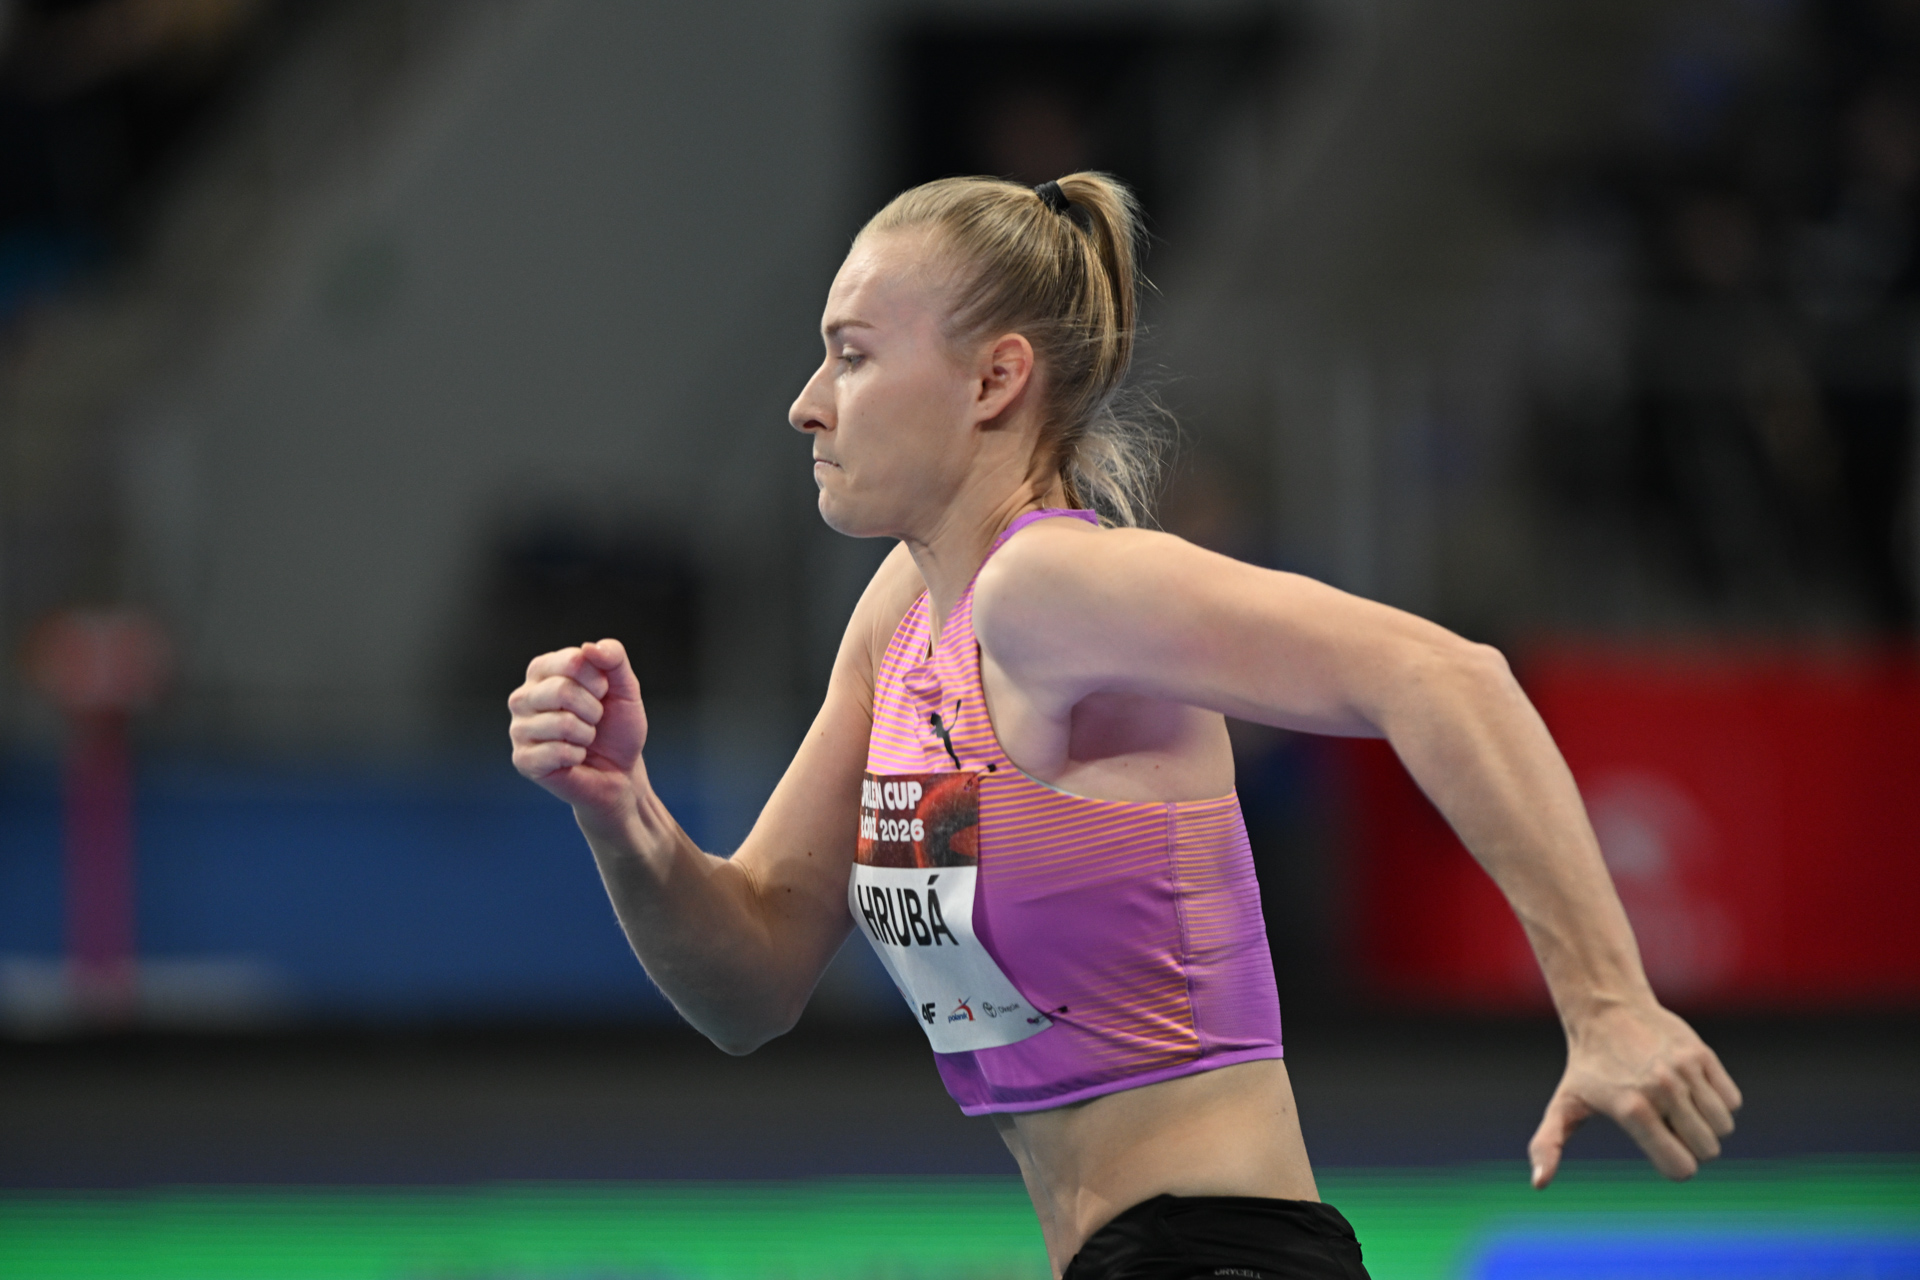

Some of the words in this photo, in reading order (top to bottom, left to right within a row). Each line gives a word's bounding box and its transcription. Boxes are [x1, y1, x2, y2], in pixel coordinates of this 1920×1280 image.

[884, 781, 922, 810] CUP
[879, 818, 925, 842] 2026
[857, 874, 959, 947] HRUBÁ
